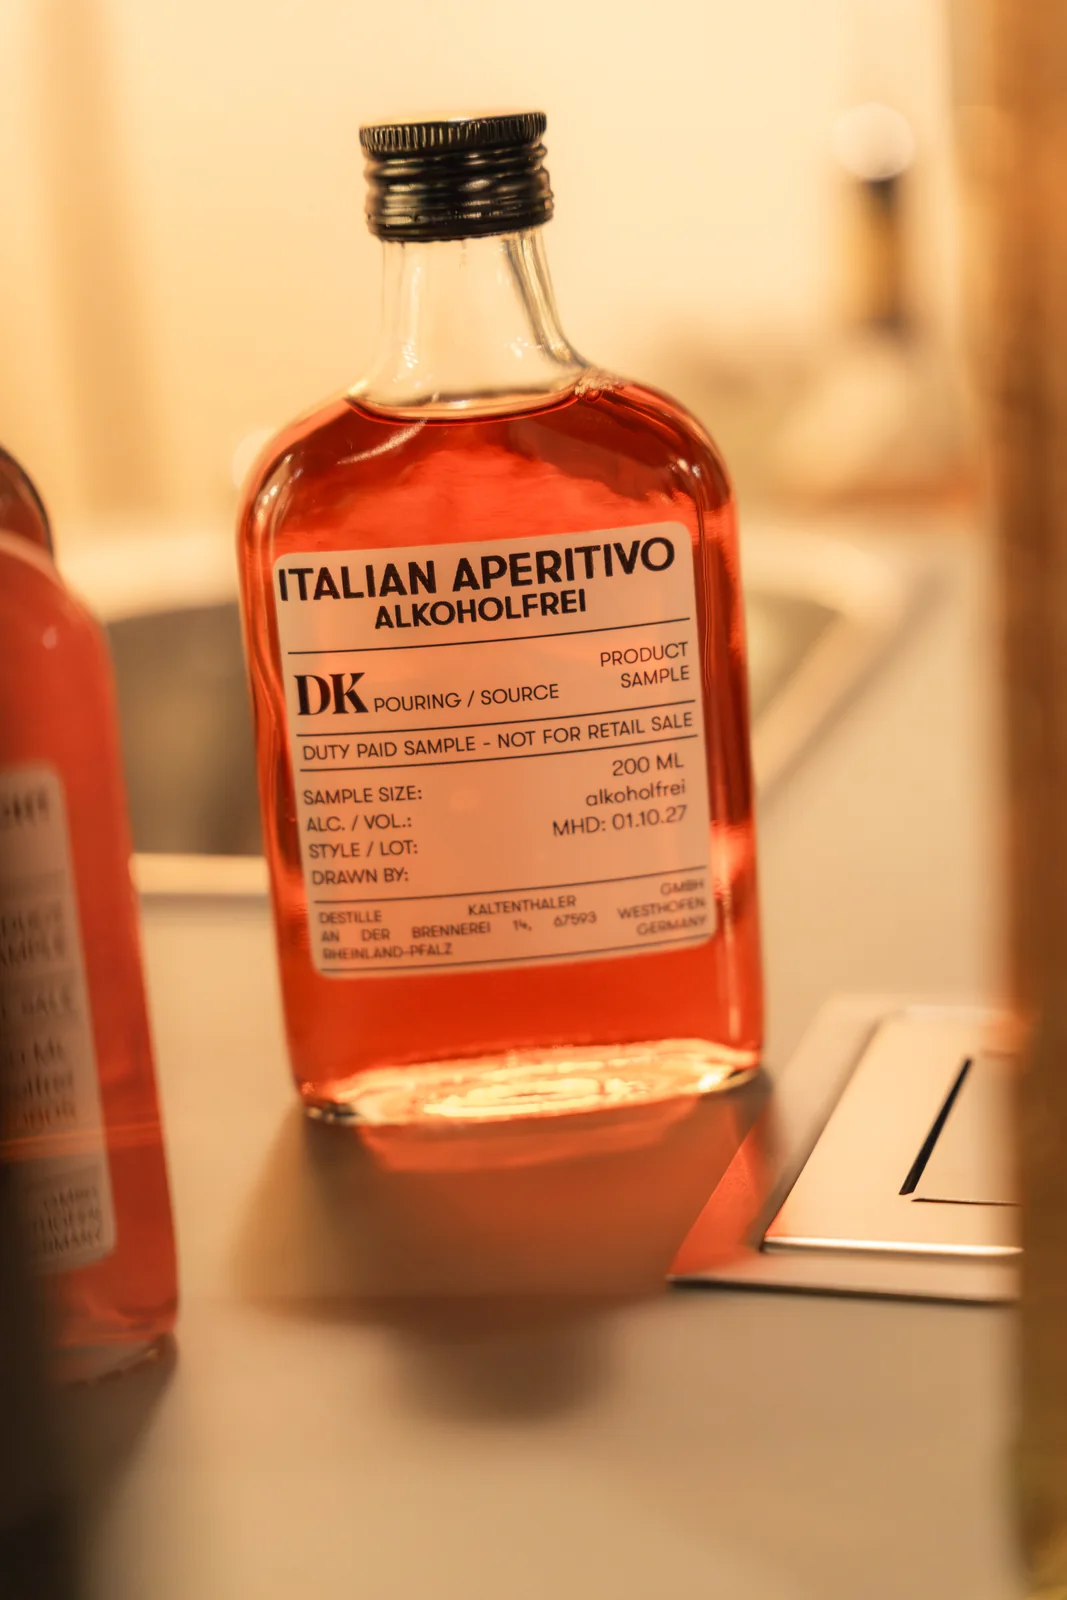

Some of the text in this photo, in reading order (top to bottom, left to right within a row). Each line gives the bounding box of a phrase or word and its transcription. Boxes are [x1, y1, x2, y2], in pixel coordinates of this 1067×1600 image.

[278, 537, 675, 601] ITALIAN APERITIVO
[375, 589, 586, 629] ALKOHOLFREI
[600, 641, 688, 667] PRODUCT
[294, 672, 559, 716] DK POURING / SOURCE
[621, 665, 690, 689] SAMPLE
[303, 744, 349, 761] DUTY
[357, 741, 397, 758] PAID
[404, 736, 476, 756] SAMPLE
[498, 730, 536, 749] NOT
[543, 726, 581, 744] FOR
[588, 719, 645, 740] RETAIL
[651, 712, 693, 732] SALE
[303, 753, 684, 806] SAMPLE SIZE: 200 ML
[307, 779, 686, 832] ALC. / VOL.: alkoholfrei
[309, 804, 687, 859] STYLE / LOT: MHD: 01.10.27
[312, 867, 408, 886] DRAWN BY:
[319, 878, 705, 924] DESTILLE KALTENTHALER GMBH
[321, 897, 705, 942] AN DER BRENNEREI 14, 67593 WESTHOFEN
[322, 915, 707, 960] RHEINLAND-PFALZ GERMANY
